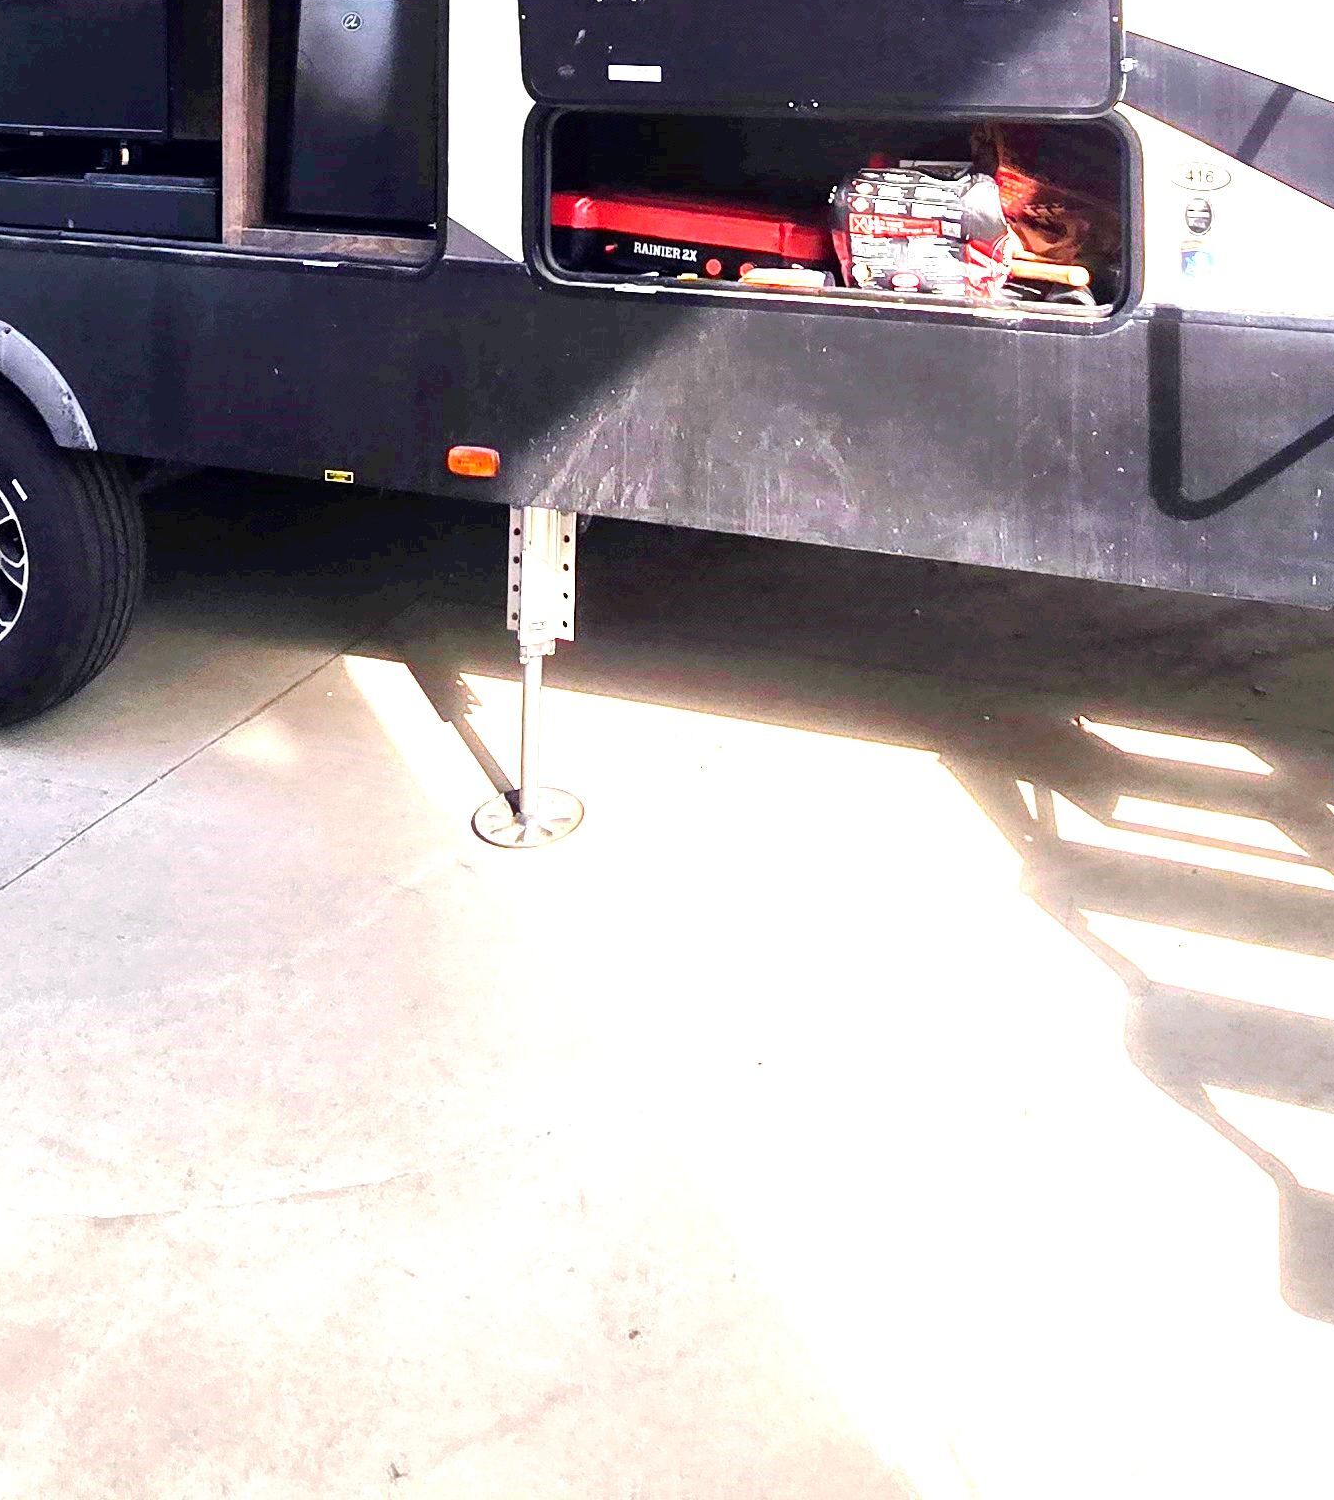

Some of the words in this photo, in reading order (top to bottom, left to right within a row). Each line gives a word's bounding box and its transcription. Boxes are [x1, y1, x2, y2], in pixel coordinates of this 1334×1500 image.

[1185, 169, 1214, 183] 416
[633, 241, 680, 260] RAINIER
[681, 248, 698, 262] 2X
